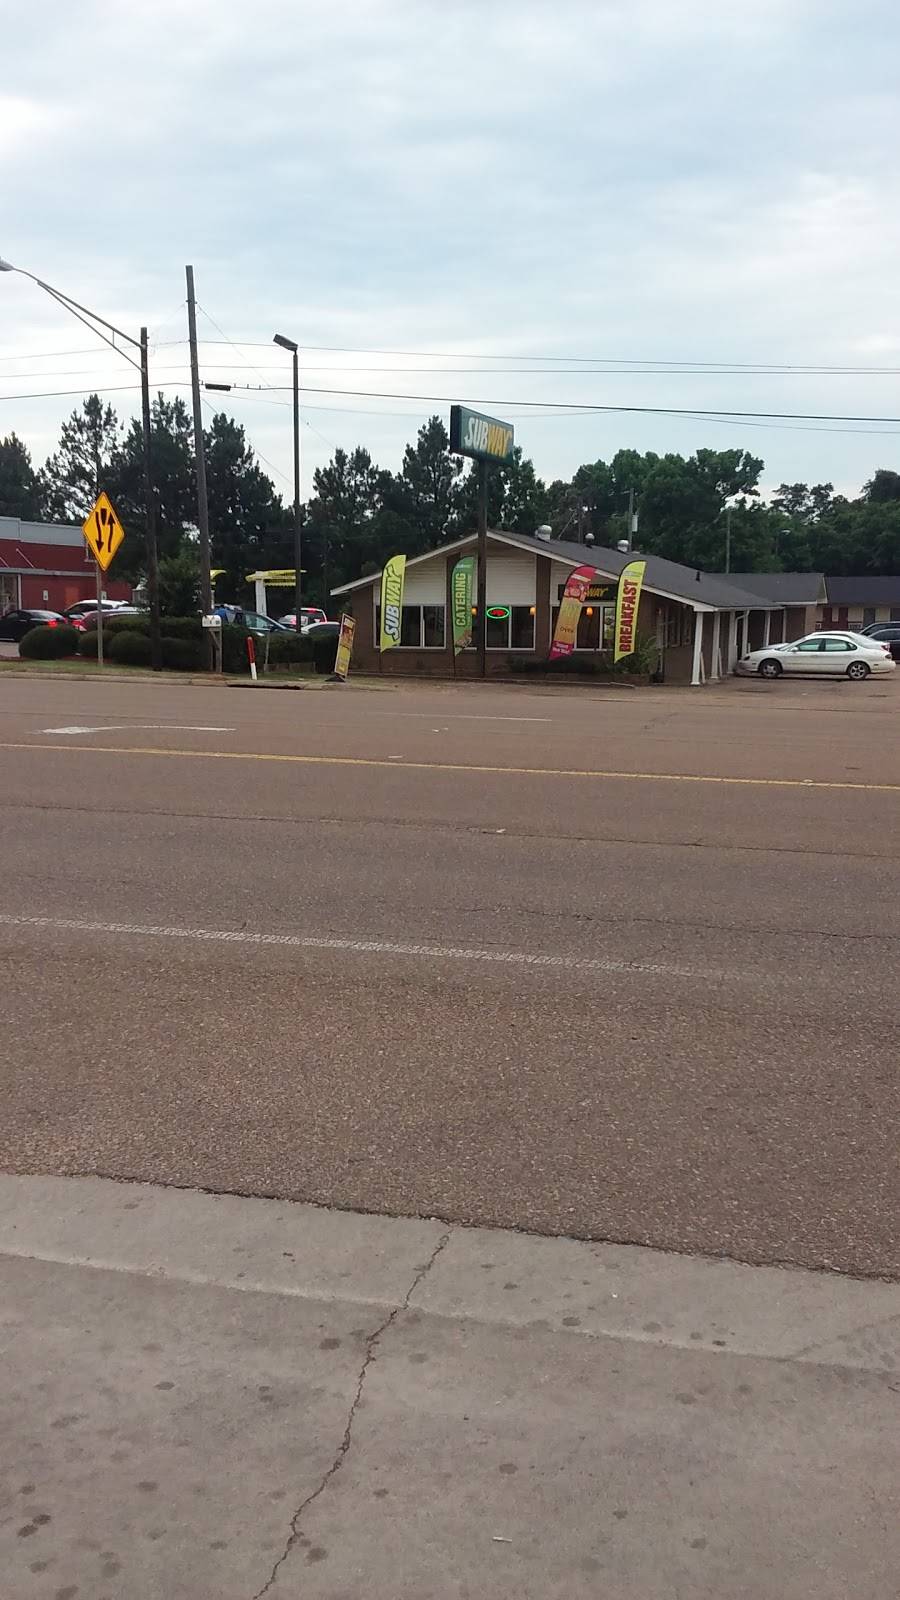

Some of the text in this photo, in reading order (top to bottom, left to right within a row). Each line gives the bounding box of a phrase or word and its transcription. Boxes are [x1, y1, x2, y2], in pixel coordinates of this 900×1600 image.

[464, 416, 512, 458] SUBWAY
[384, 563, 403, 642] SUBWAY
[455, 572, 467, 627] CATERING
[586, 587, 609, 598] WAY
[619, 579, 639, 653] BREAKFAST
